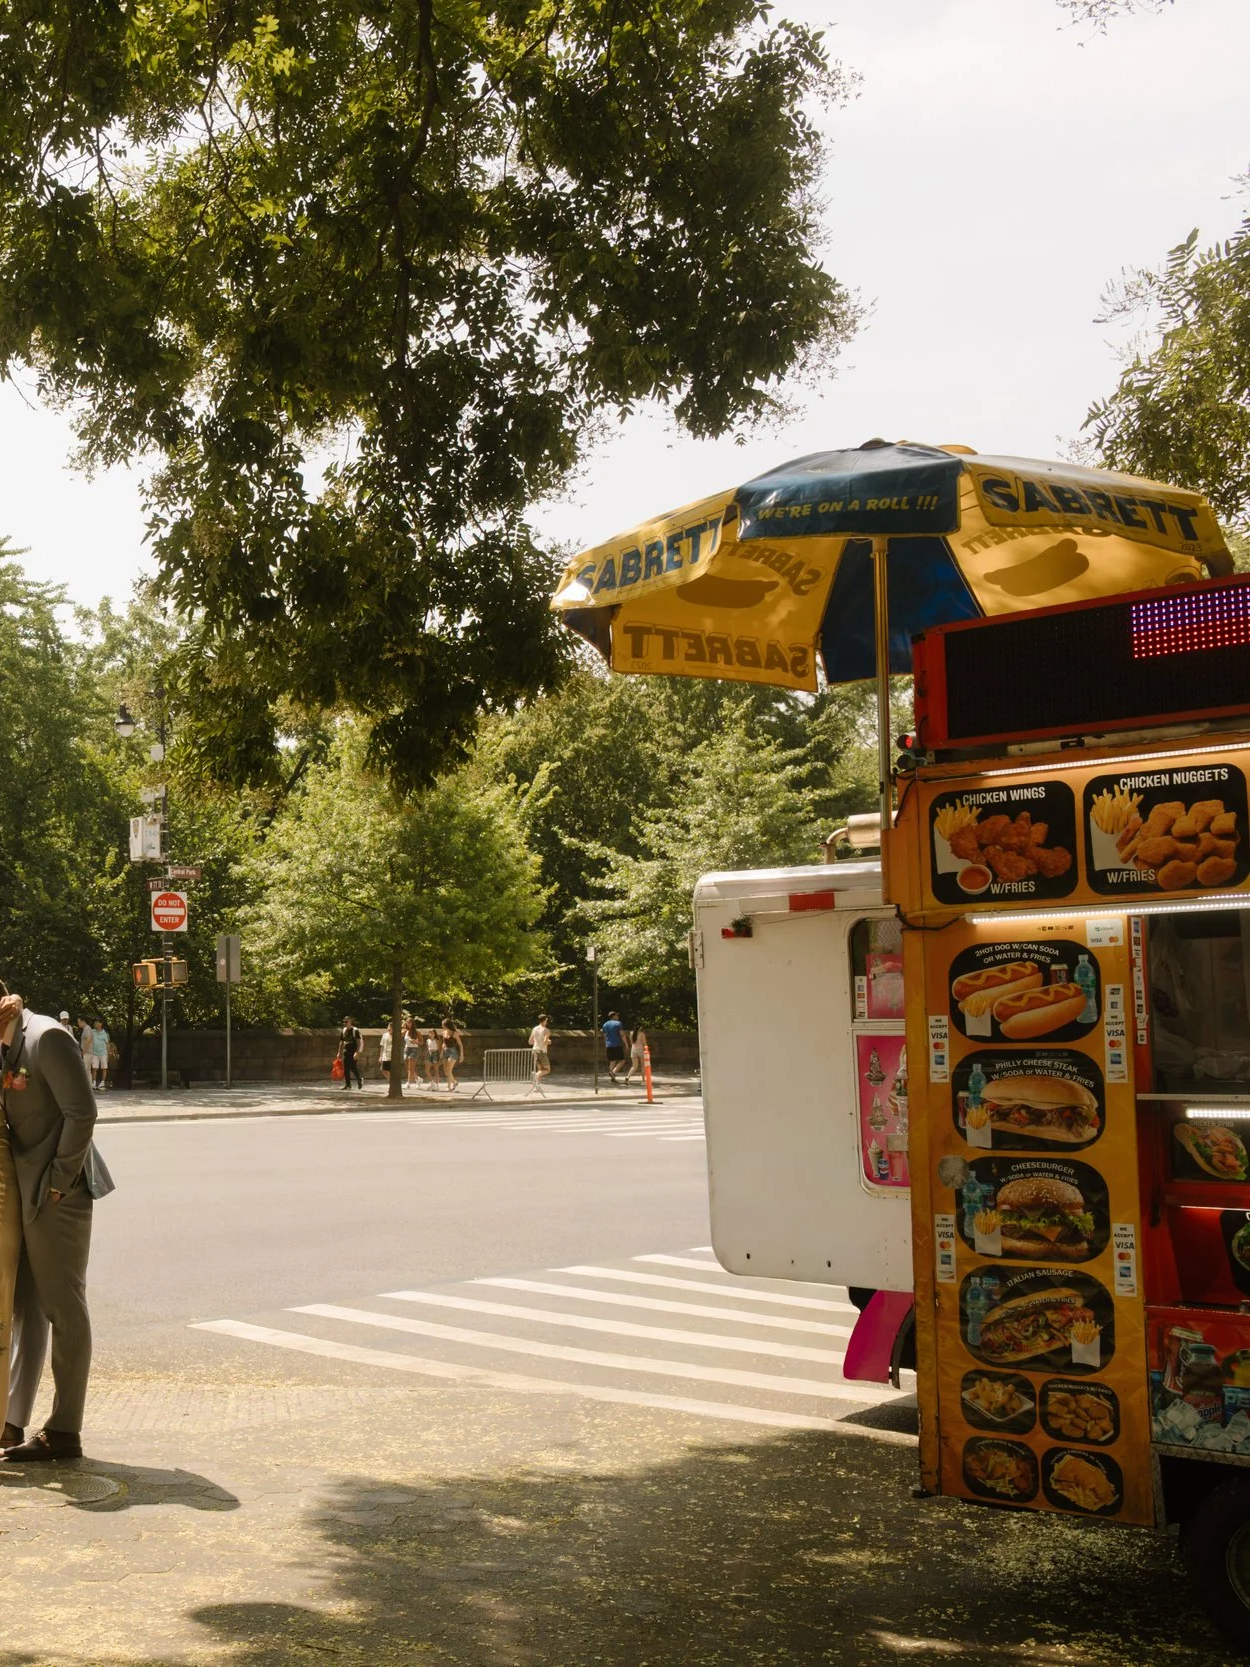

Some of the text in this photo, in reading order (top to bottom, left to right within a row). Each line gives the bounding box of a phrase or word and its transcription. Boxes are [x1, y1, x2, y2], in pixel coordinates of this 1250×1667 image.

[757, 504, 812, 519] WE'RE
[817, 501, 842, 513] ON
[850, 499, 862, 512] A
[865, 496, 909, 512] ROLL
[982, 478, 1199, 541] SABRETT
[1179, 543, 1203, 552] 2023
[575, 517, 723, 594] SABRETT
[1120, 768, 1229, 790] CHICKEN NUGGETS
[962, 787, 1046, 806] CHICKEN WINGS
[1107, 869, 1156, 883] W/FRIES
[990, 880, 1036, 895] W/FRIES
[159, 916, 180, 924] ENTER
[995, 944, 1012, 953] DOG
[1012, 943, 1038, 952] W/CAN
[1039, 944, 1060, 957] SODA
[983, 951, 1052, 964] OR WATER & FRIES
[931, 1032, 949, 1040] VISA
[1106, 1029, 1126, 1037] VISA
[995, 1059, 1079, 1074] PHILLY CHEESE STEAK
[990, 1070, 1025, 1081] W/SODA
[1034, 1068, 1063, 1079] WATER
[1063, 1073, 1072, 1081] &
[1072, 1075, 1096, 1089] FRIES
[1011, 1161, 1075, 1176] CHEESEBURGER
[1032, 1171, 1054, 1180] WATER
[1060, 1175, 1079, 1185] FRIES
[937, 1231, 955, 1239] VISA
[1115, 1240, 1135, 1250] VISA
[1005, 1270, 1036, 1288] ITALIAN
[1035, 1268, 1074, 1279] SAUSAGE
